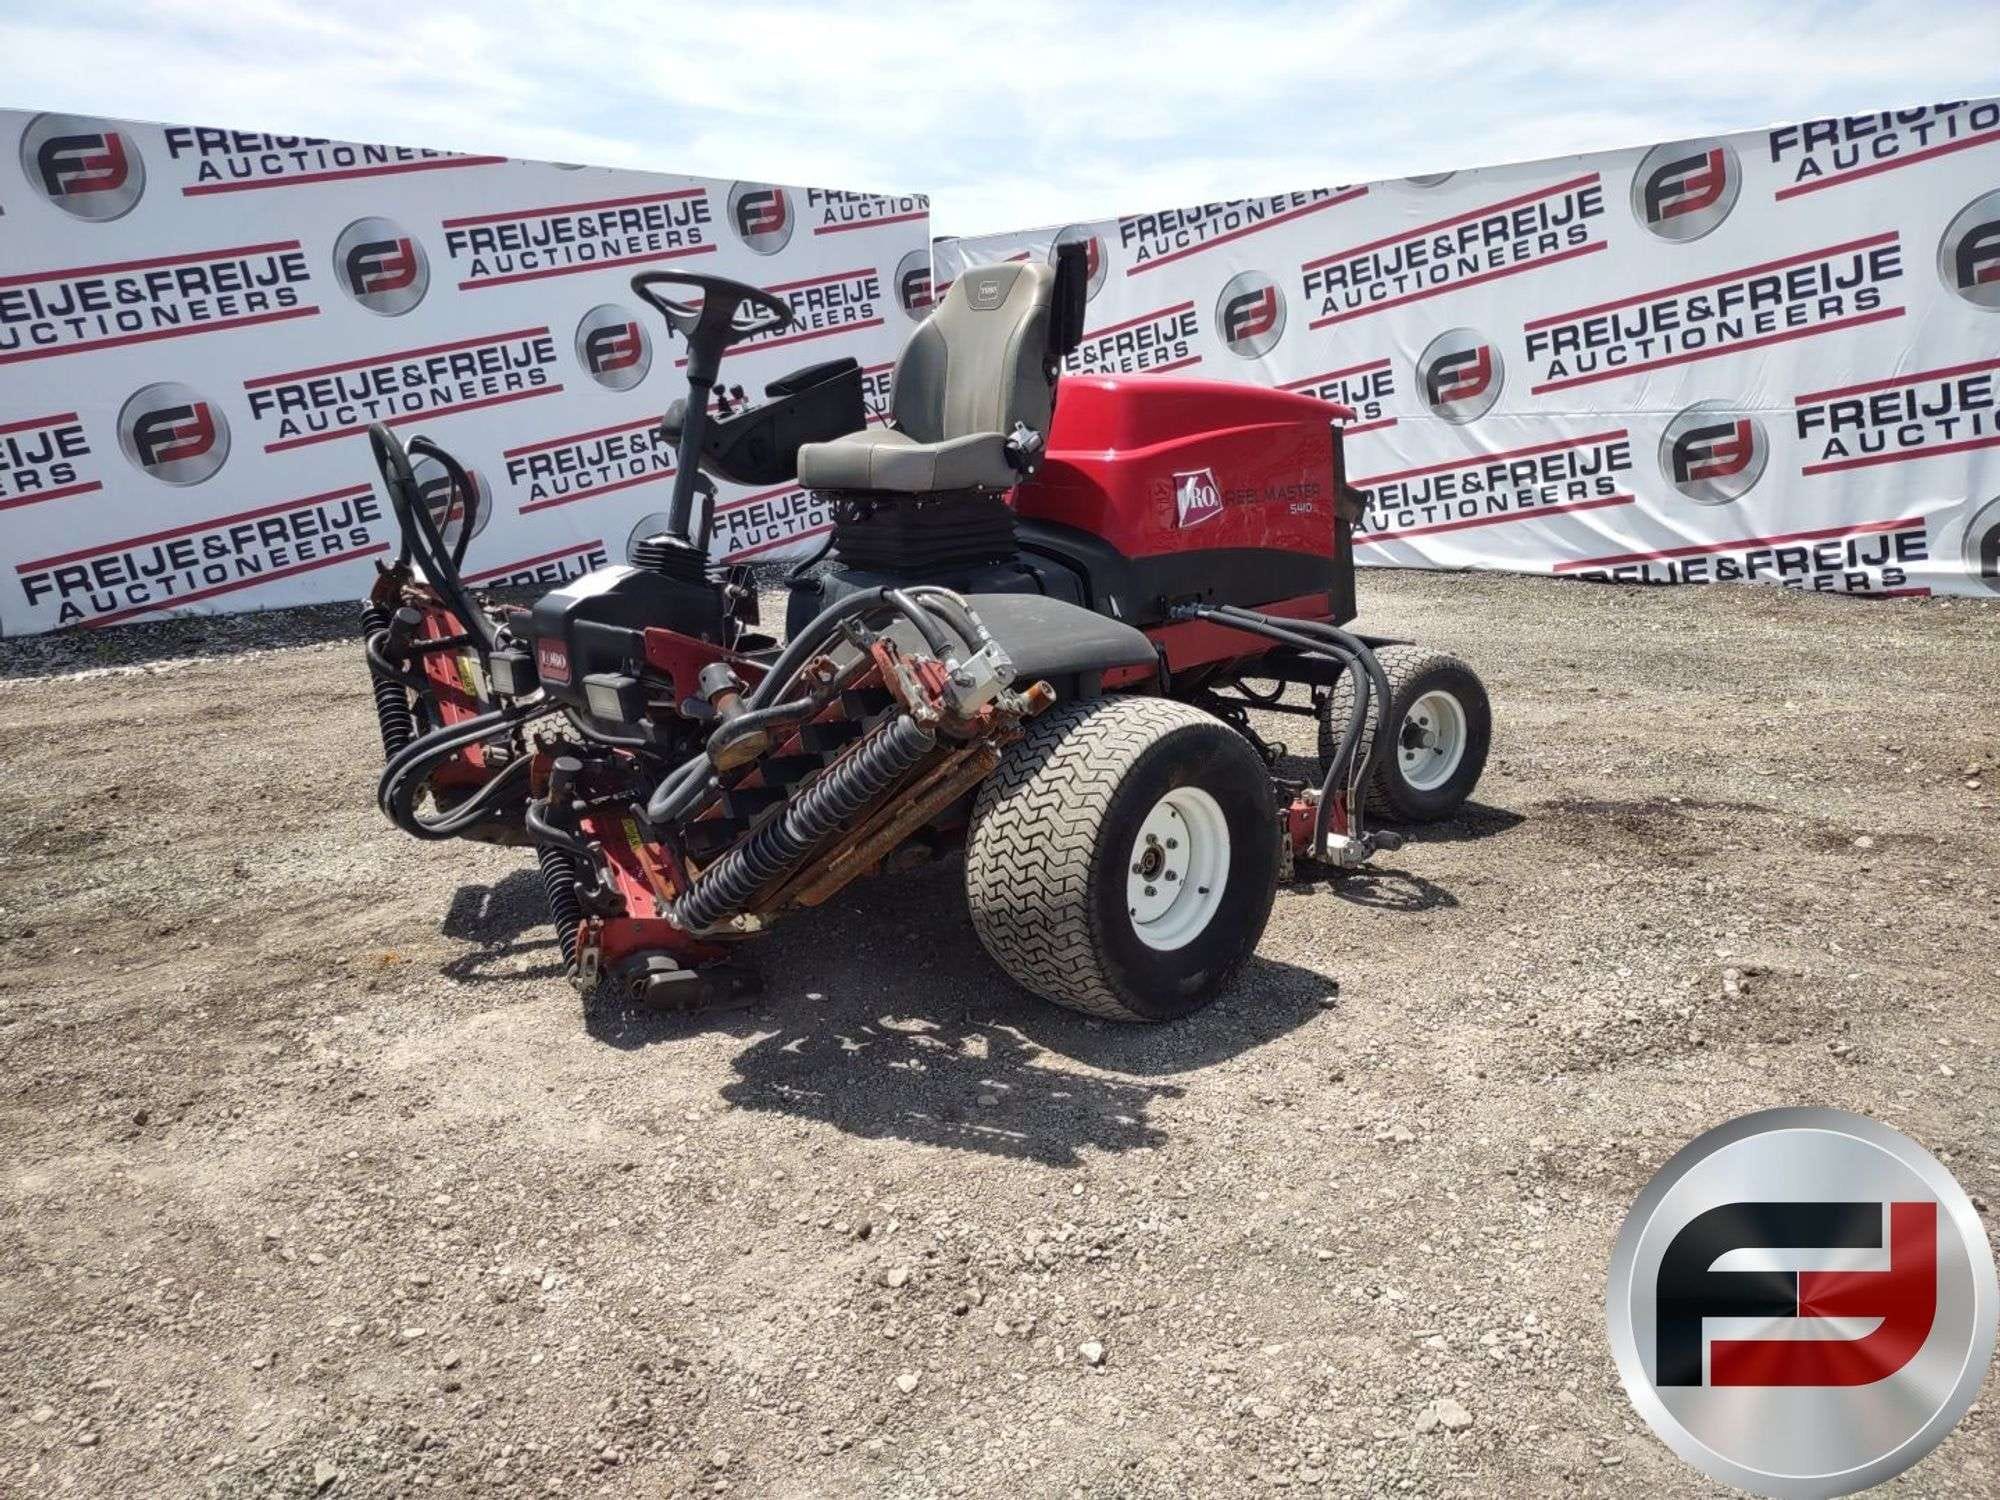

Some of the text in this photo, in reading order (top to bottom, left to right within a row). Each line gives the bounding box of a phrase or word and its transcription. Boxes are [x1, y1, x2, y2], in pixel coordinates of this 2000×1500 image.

[446, 199, 711, 258] FREIJE&FREIJE
[470, 227, 702, 277] AUCTIONEERS
[1303, 185, 1604, 299] FREIJE&FREIJE
[1321, 223, 1588, 316] AUCTIONEERS
[1525, 245, 1903, 361] FREIJE&FREIJE
[1547, 287, 1881, 379] AUCTIONEERS
[248, 338, 556, 420] FREIJE&FREIJE
[279, 367, 547, 438] AUCTIONEERS
[1796, 375, 1994, 440] FREIJE
[1822, 410, 2000, 459] AUCTI
[20, 494, 382, 606] FREIJE&FREIJE
[58, 527, 370, 623] AUCTIONEERS
